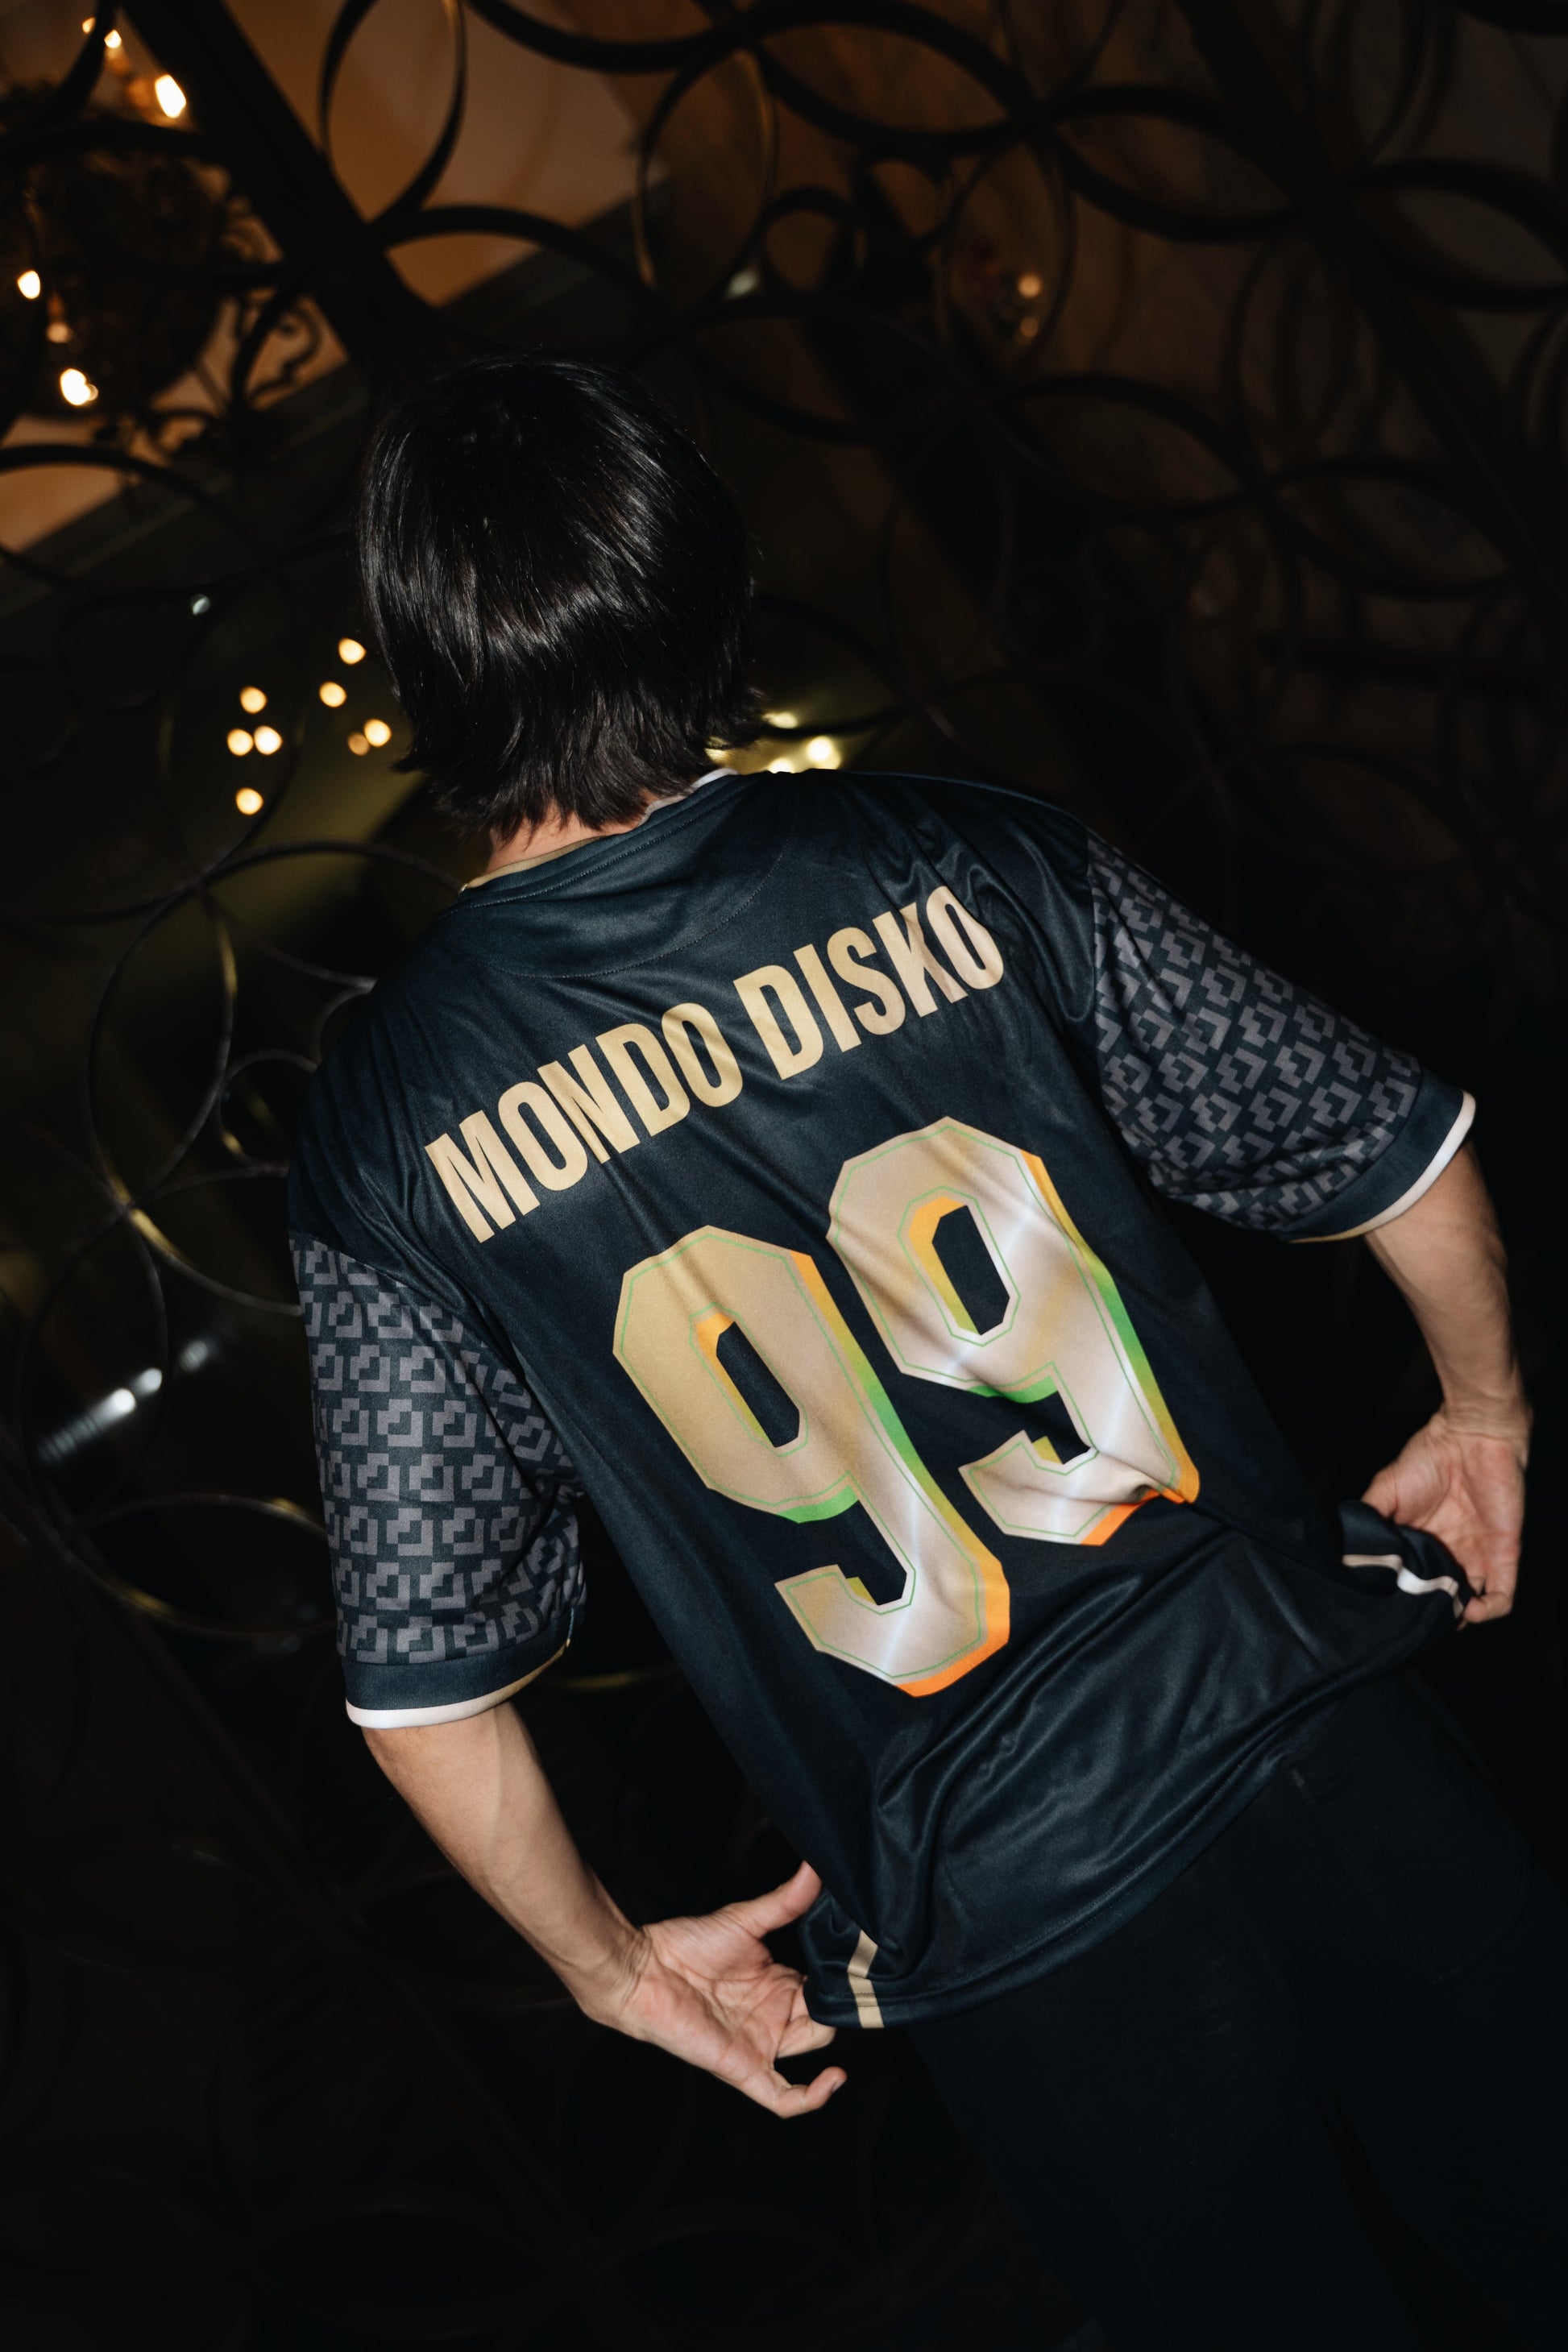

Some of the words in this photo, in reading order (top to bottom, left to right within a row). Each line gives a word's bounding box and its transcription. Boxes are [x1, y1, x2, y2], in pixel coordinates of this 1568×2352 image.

[425, 1002, 744, 1243] MONDO
[732, 885, 1006, 1081] DISKO
[612, 1116, 1201, 1698] 99
